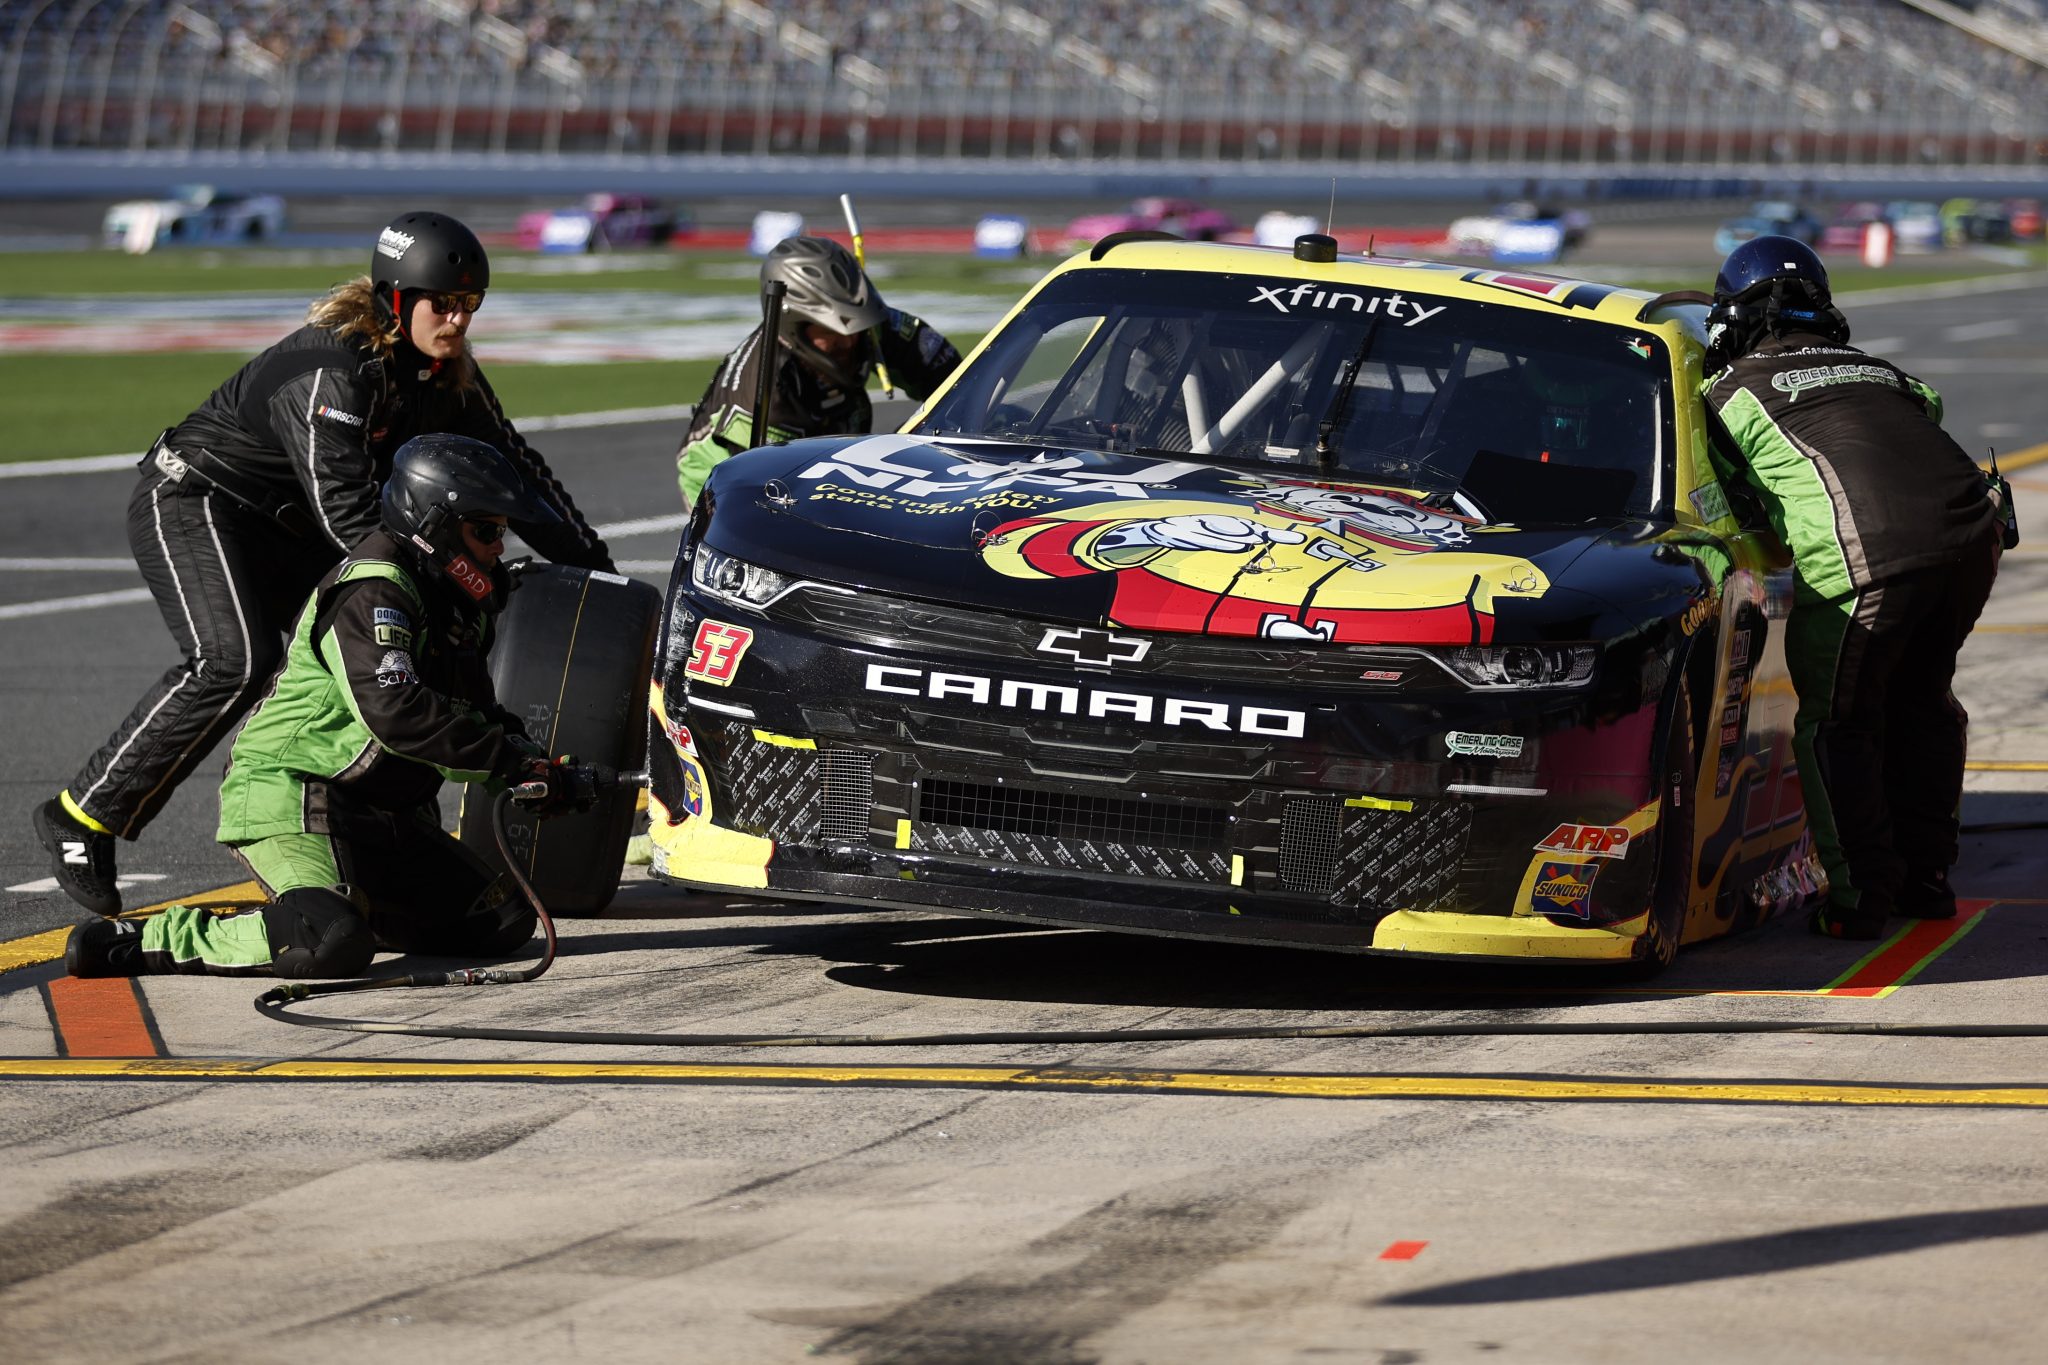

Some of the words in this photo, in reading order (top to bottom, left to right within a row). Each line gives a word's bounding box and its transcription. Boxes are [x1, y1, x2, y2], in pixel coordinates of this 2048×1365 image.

[1248, 283, 1447, 326] xfinity
[328, 408, 364, 427] NASCAR
[797, 462, 1149, 498] NFPA
[808, 492, 892, 509] starts
[905, 502, 967, 515] with
[973, 496, 1037, 510] YOU.
[815, 483, 952, 508] Cooking
[961, 489, 1064, 505] safety
[452, 561, 485, 593] DAD
[378, 627, 412, 650] LIFE
[687, 622, 750, 680] 53
[865, 664, 1306, 738] CAMARO
[1540, 826, 1629, 852] ARP
[62, 842, 88, 864] N
[1537, 882, 1587, 899] SUNOCO
